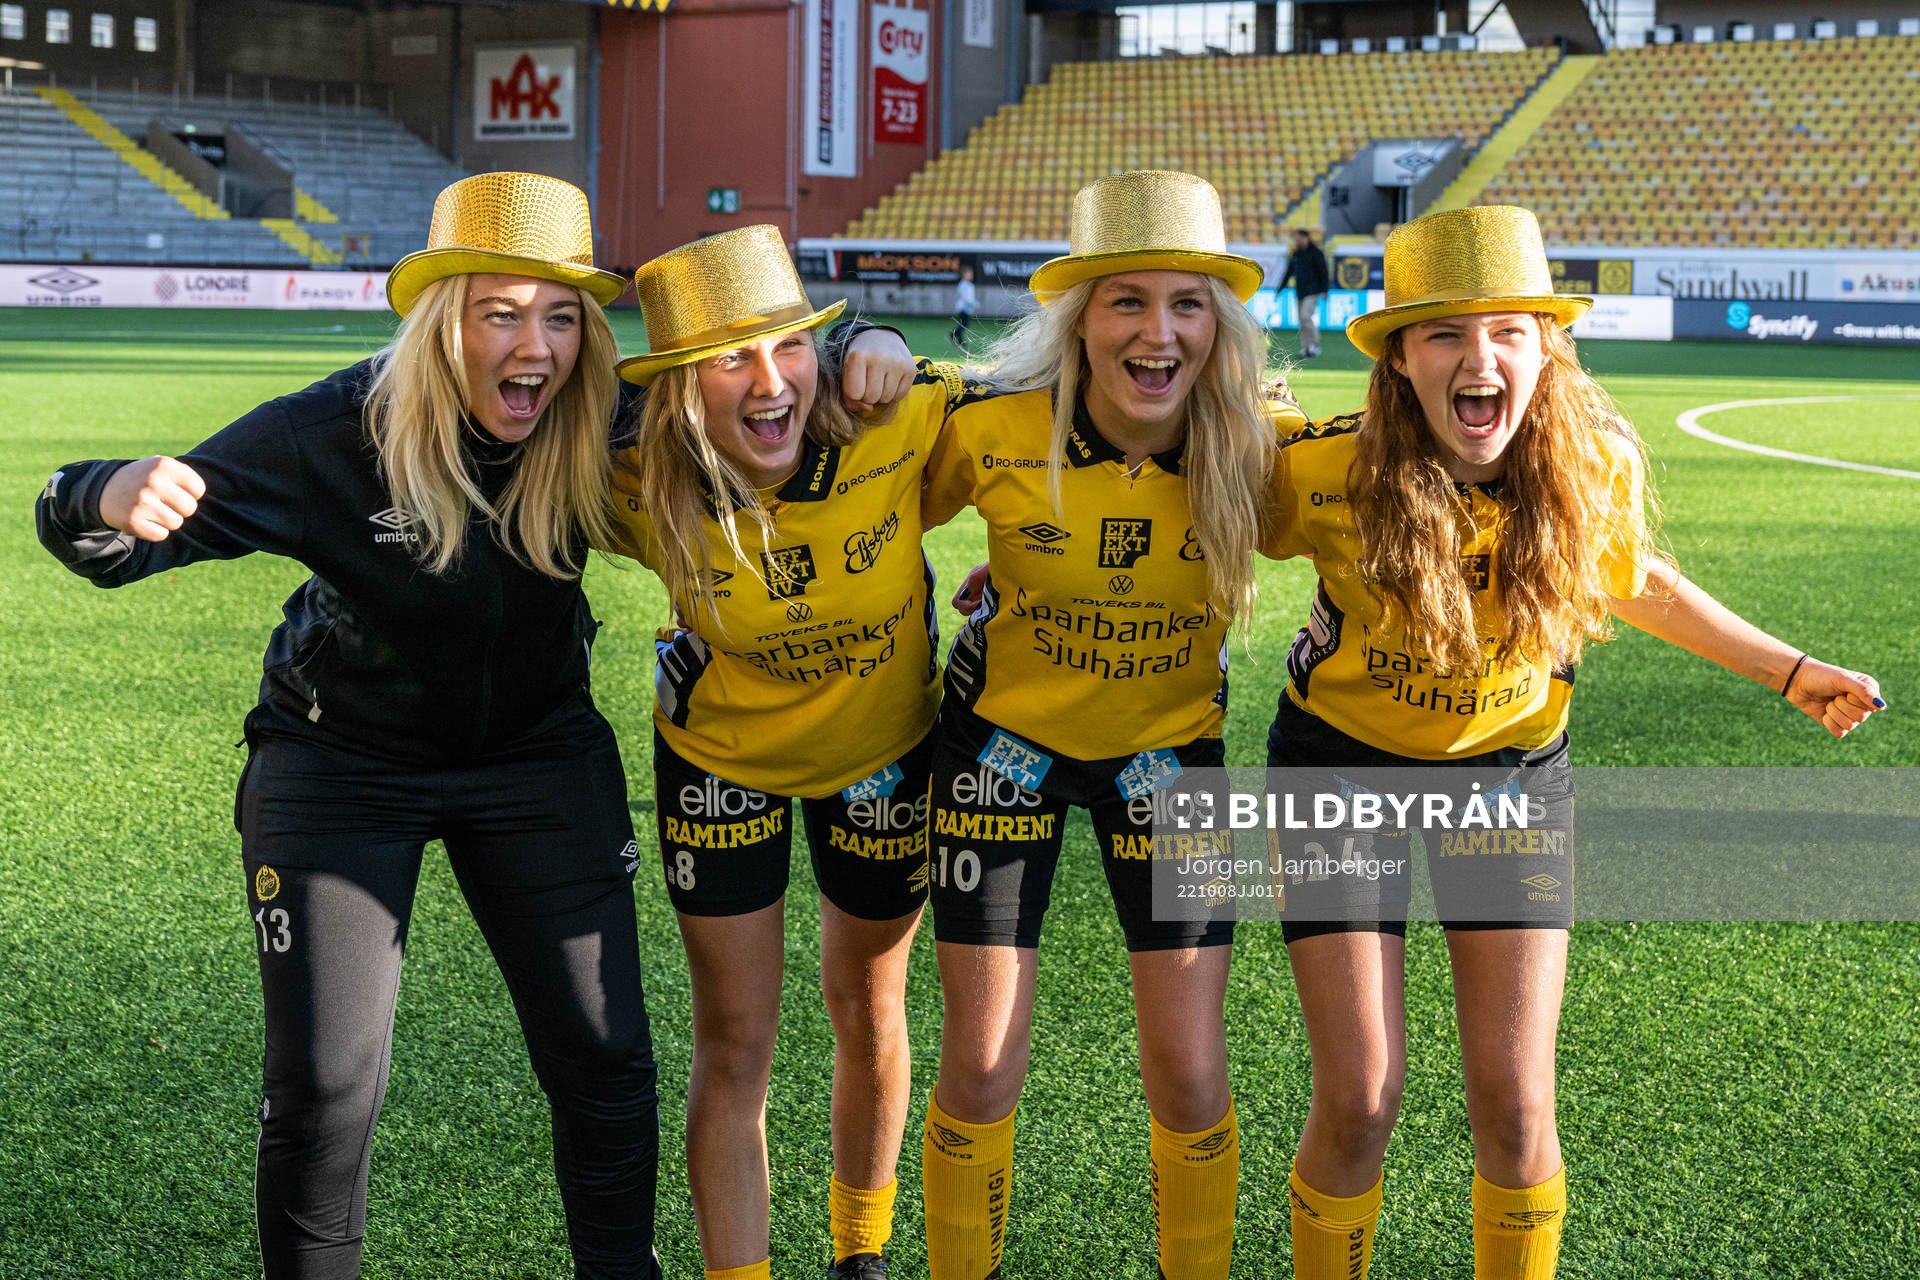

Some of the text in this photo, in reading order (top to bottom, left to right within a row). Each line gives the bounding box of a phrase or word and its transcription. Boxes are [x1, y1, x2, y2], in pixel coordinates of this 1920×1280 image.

[490, 53, 560, 119] MAX
[850, 449, 915, 487] RO-GRUPPEN
[374, 531, 419, 543] umbro
[1103, 536, 1147, 552] EKT
[1104, 521, 1144, 537] EFF
[1025, 542, 1065, 556] umbro
[1010, 587, 1217, 644] Sparbanken
[1071, 597, 1142, 609] TOVEKS
[754, 616, 855, 643] TOVEKS BIL
[1033, 626, 1193, 681] Sjuhärad
[679, 776, 768, 818] ellos
[665, 806, 785, 849] RAMIRENT
[935, 807, 1056, 842] RAMIRENT
[1111, 828, 1232, 861] RAMIRENT
[1439, 829, 1567, 858] RAMIRENT
[675, 850, 696, 891] 8
[938, 846, 982, 893] 10
[255, 907, 293, 953] 13
